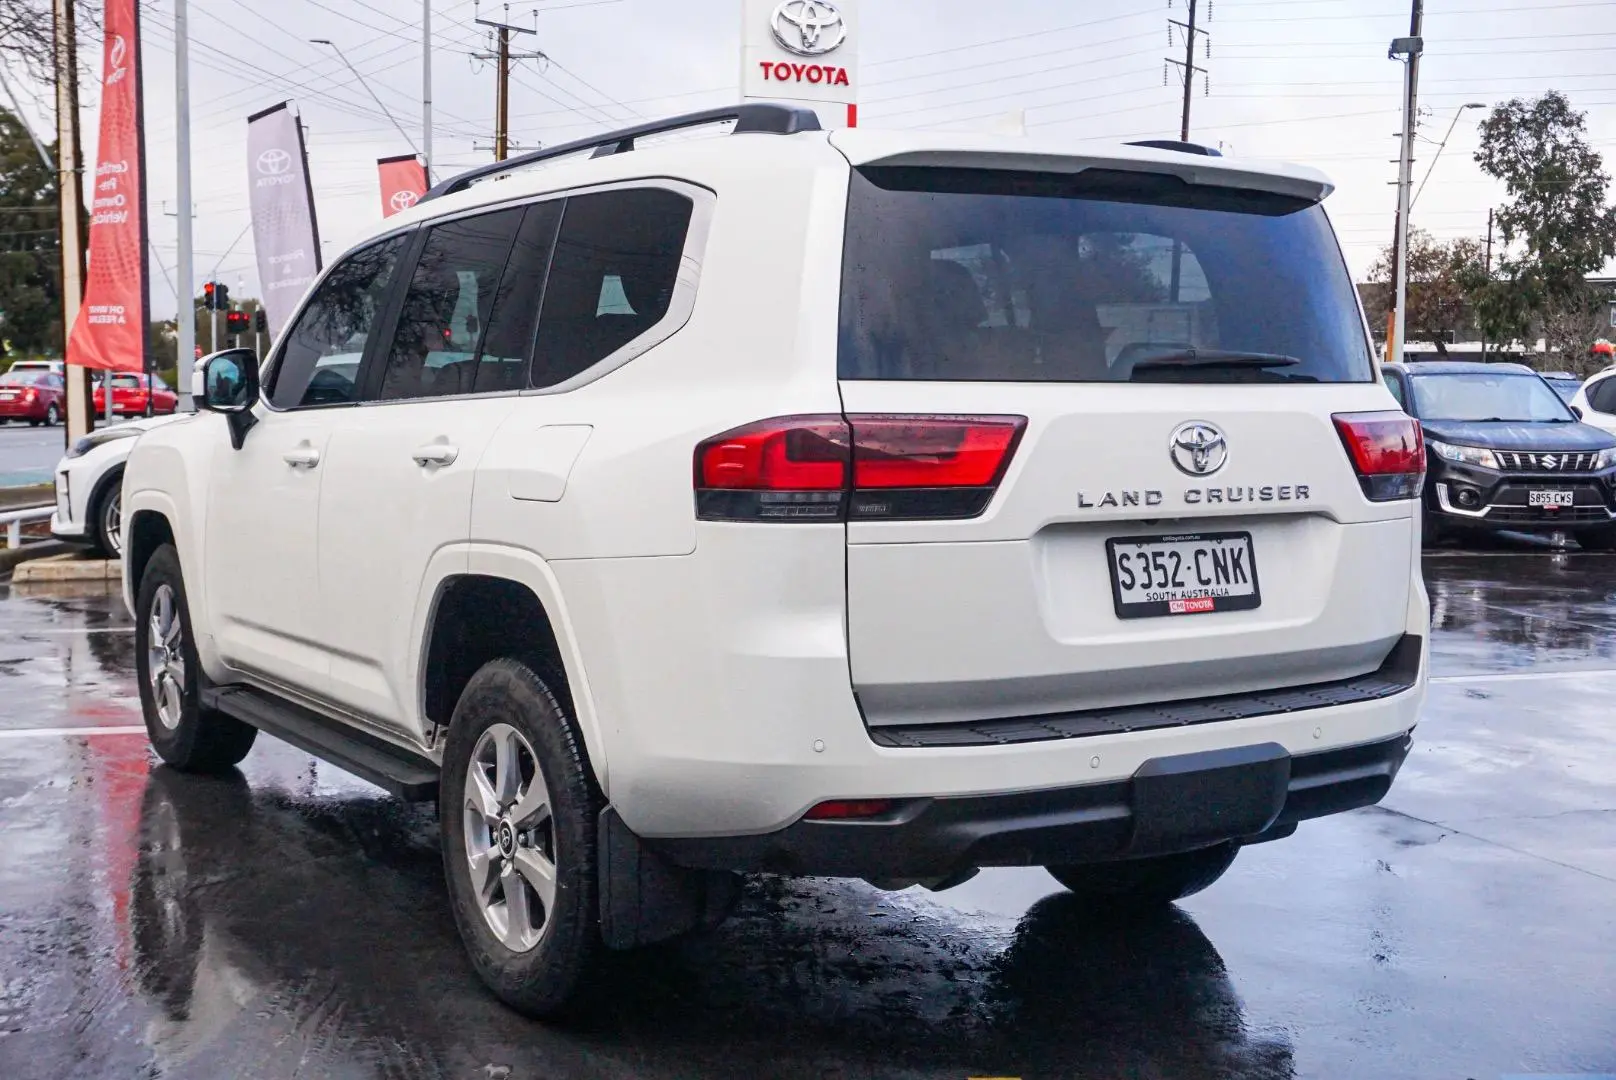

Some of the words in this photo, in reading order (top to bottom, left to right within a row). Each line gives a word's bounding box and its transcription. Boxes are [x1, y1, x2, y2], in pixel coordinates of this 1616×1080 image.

[760, 61, 849, 86] TOYOTA
[1077, 490, 1163, 508] LAND
[1184, 484, 1310, 504] CRUISER
[1146, 591, 1177, 600] SOUTH
[1181, 588, 1229, 600] AUSTRALIA
[1185, 599, 1214, 610] TOYOTA
